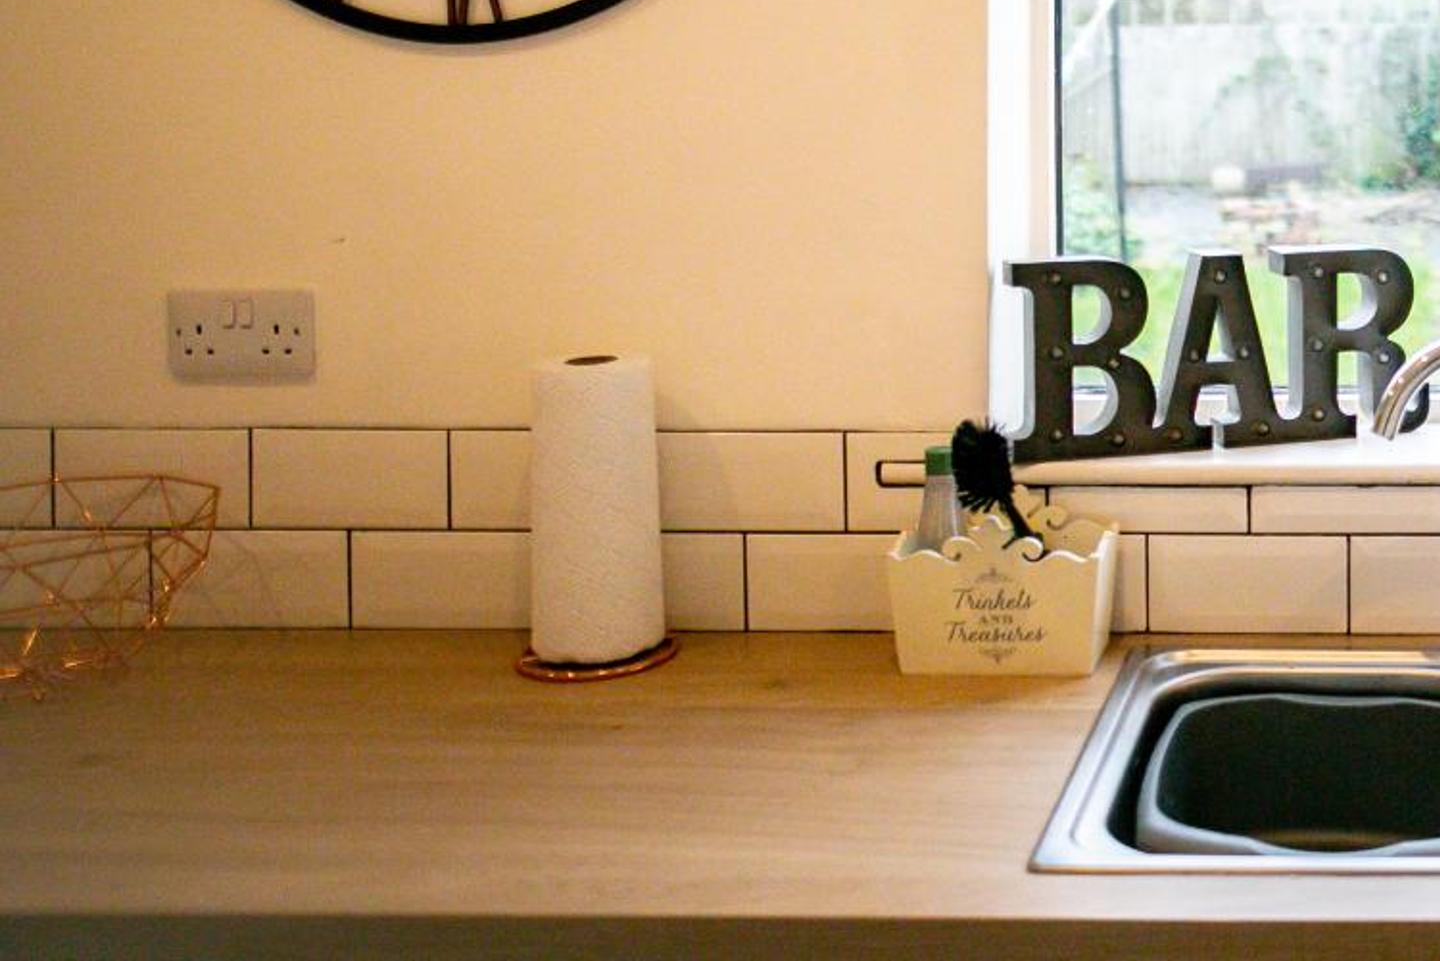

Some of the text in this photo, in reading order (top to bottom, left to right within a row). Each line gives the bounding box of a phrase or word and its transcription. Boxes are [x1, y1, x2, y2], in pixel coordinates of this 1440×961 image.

[1004, 249, 1430, 462] BAR
[952, 586, 1036, 611] Trinkets
[944, 620, 1047, 643] Treasures
